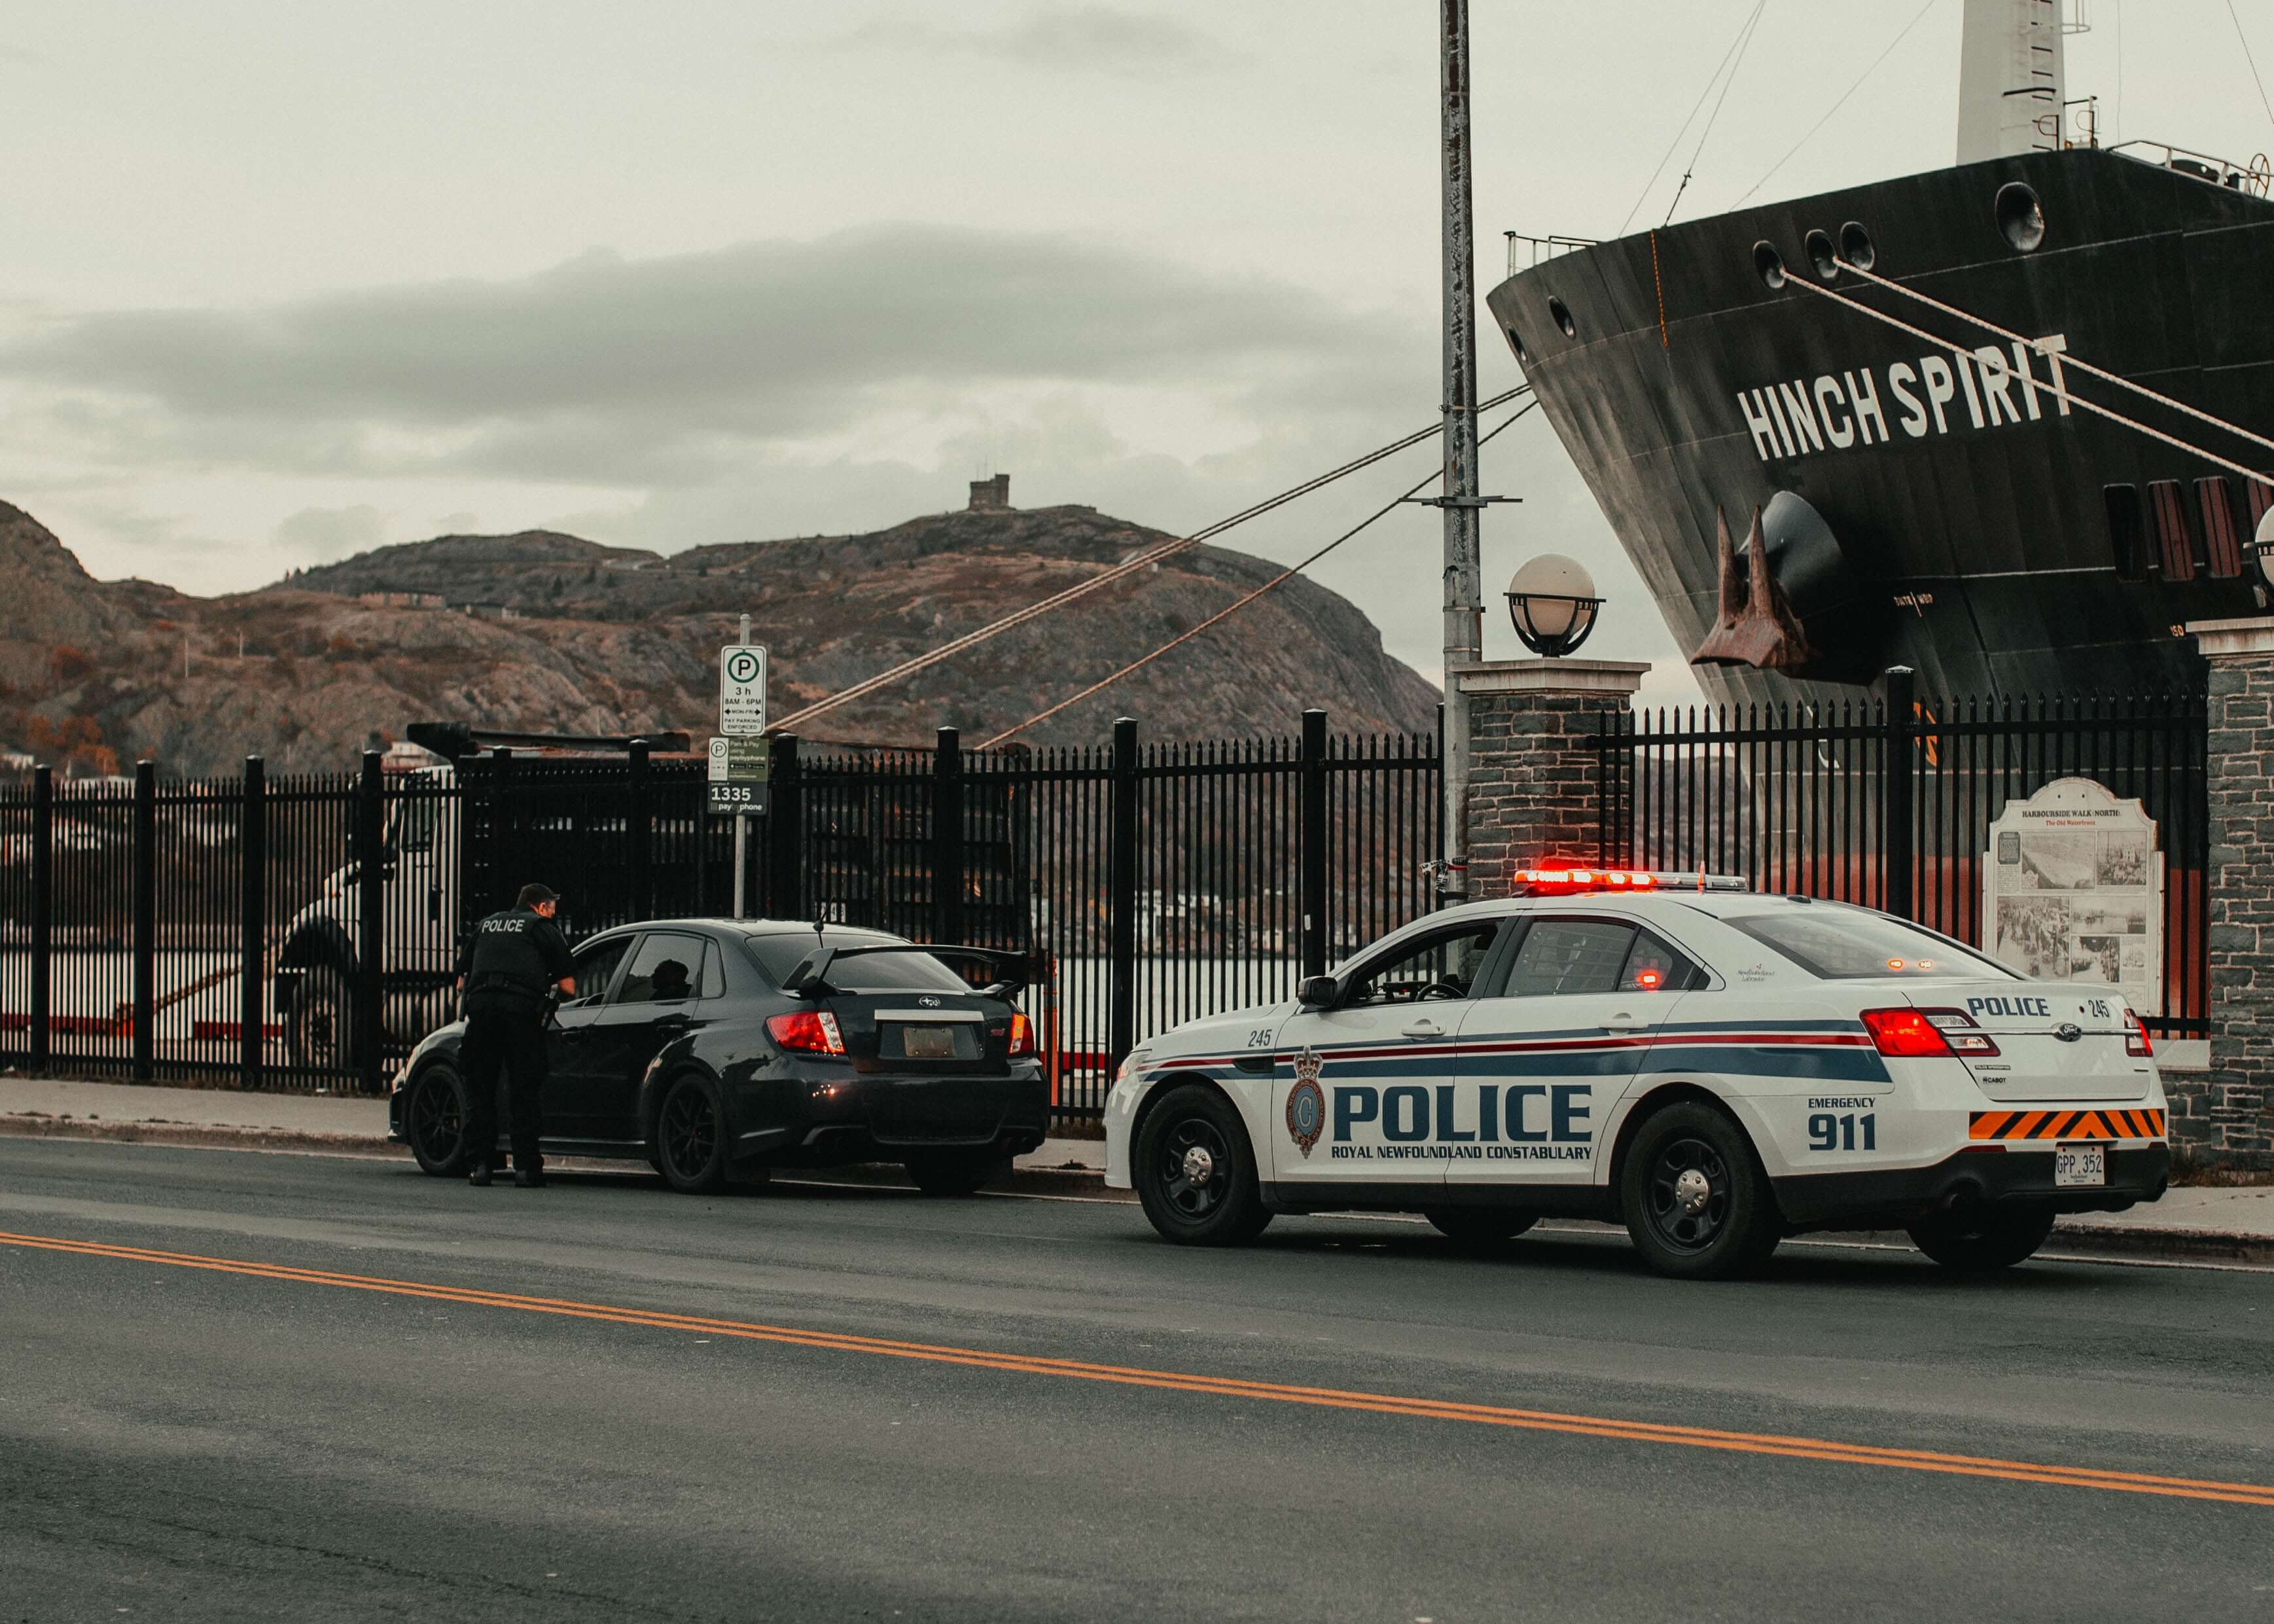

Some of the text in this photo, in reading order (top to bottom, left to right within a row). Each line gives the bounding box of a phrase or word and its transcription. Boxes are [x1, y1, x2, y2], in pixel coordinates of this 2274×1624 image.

[1737, 334, 2070, 461] HINCH SPIRIT
[738, 660, 751, 676] P
[736, 686, 751, 696] 3 h
[715, 745, 723, 754] P
[711, 787, 751, 801] 1335
[482, 919, 525, 933] POLICE
[1966, 997, 2110, 1017] POLICE 245
[1248, 1029, 1272, 1047] 245
[1808, 1097, 1875, 1108] EMERGENCY
[1333, 1085, 1592, 1142] POLICE
[1808, 1114, 1875, 1150] 911
[1332, 1146, 1591, 1159] ROYAL NEWFOUNDLAND CONSTABULARY
[2057, 1155, 2102, 1173] GPP 352
